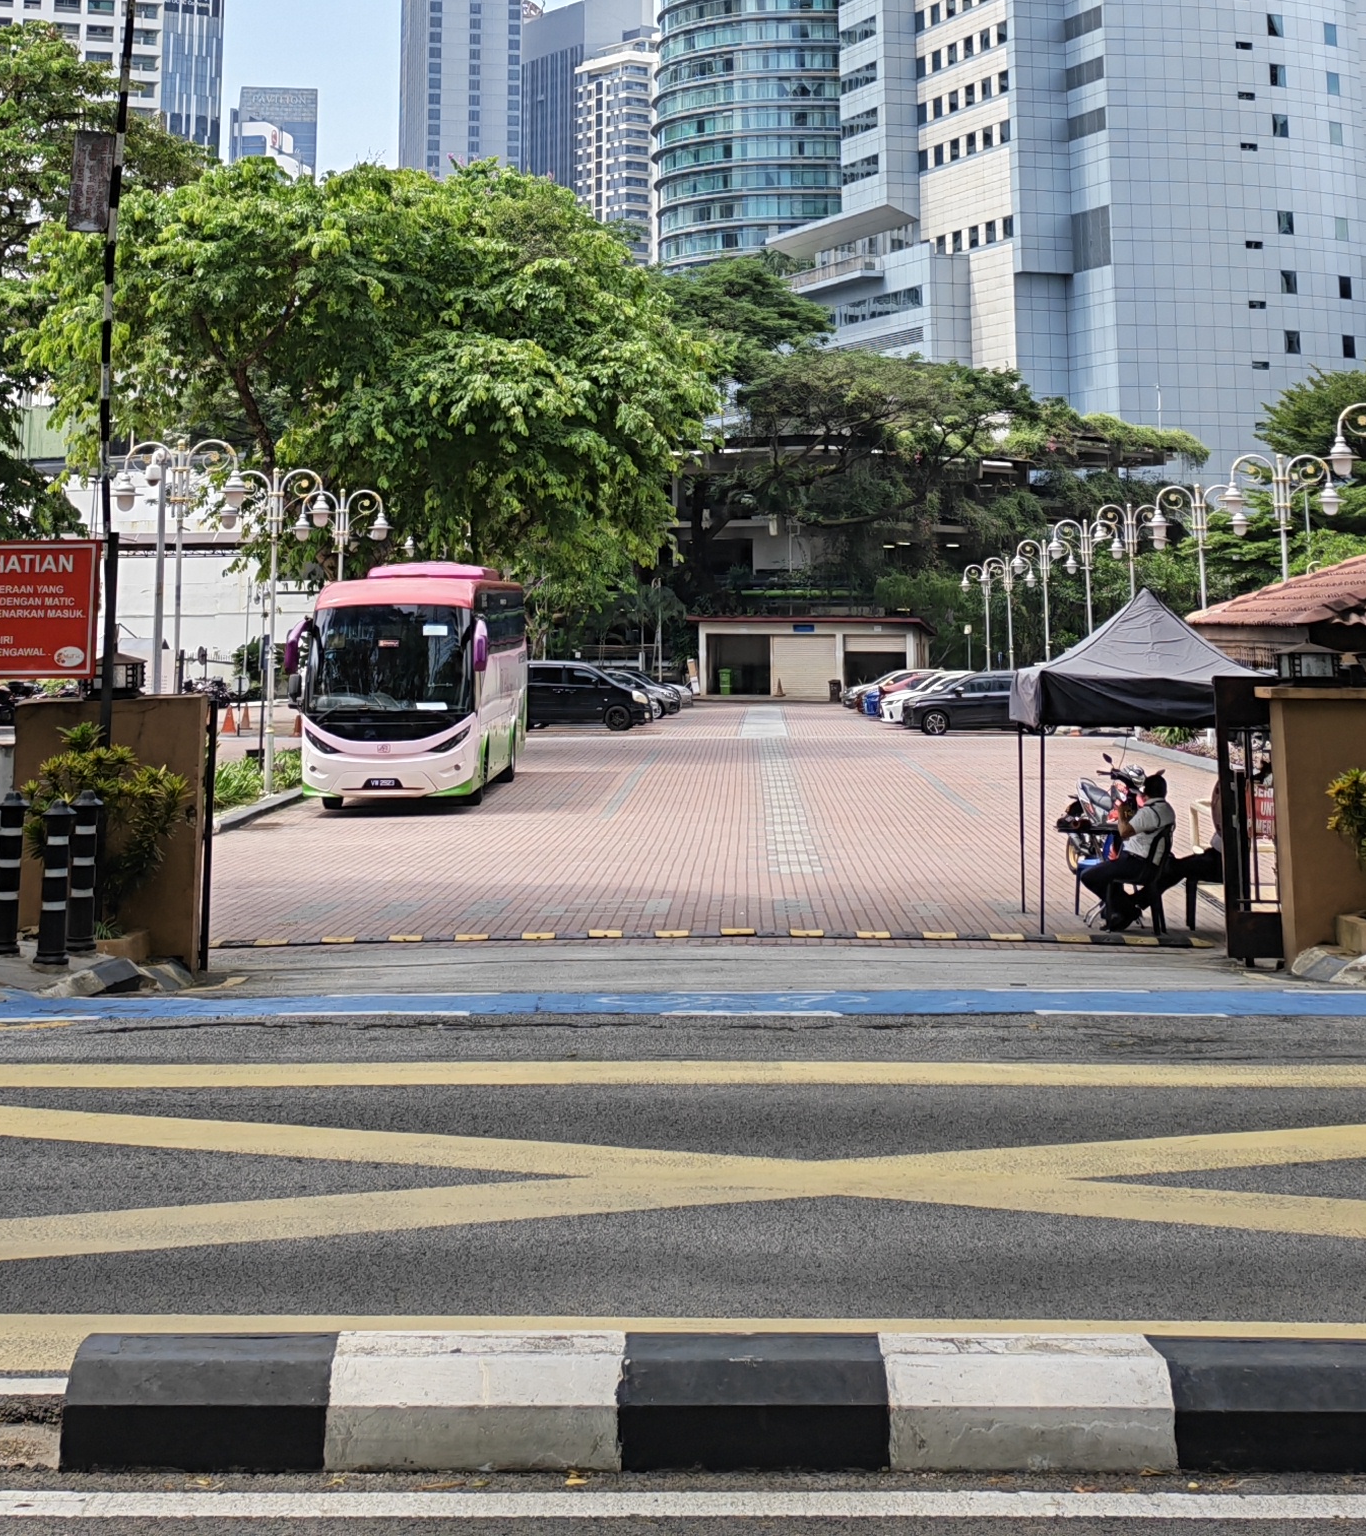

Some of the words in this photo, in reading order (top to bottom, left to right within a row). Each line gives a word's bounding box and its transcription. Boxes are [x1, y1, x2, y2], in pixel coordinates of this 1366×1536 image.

[37, 585, 64, 594] YANG
[0, 597, 41, 606] DENGAN
[44, 597, 75, 606] MATIC
[46, 609, 86, 618] MASUK.
